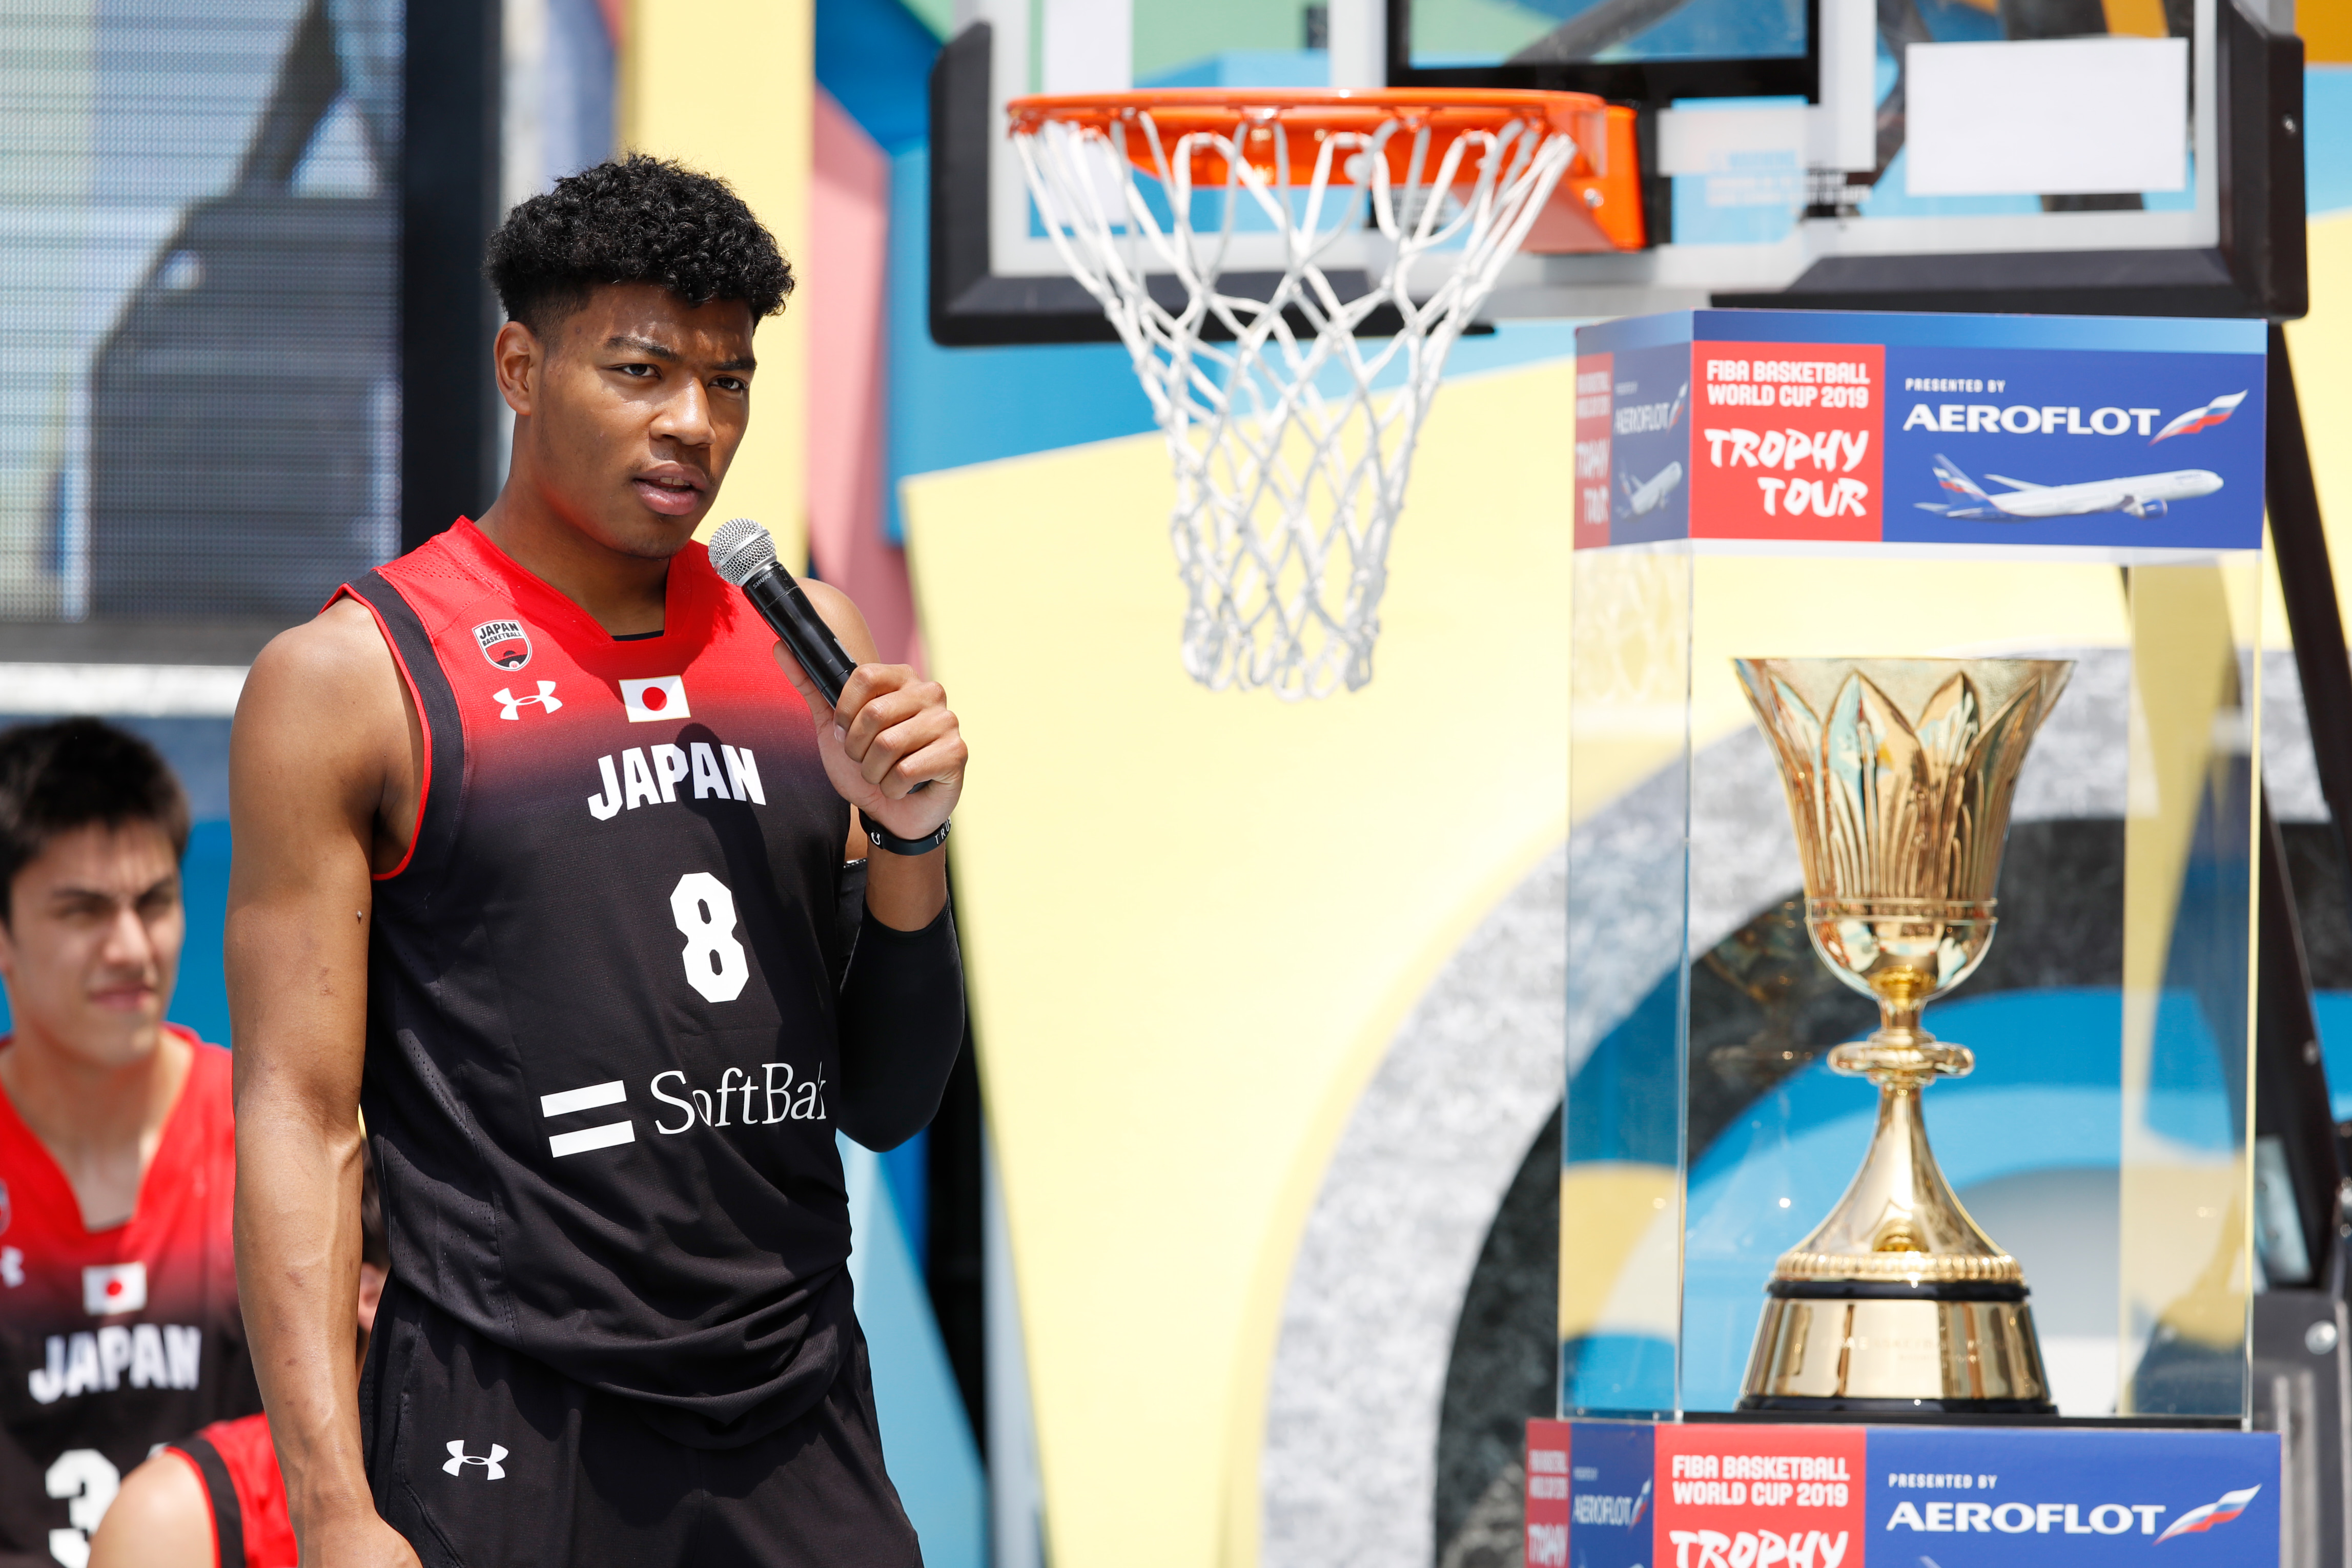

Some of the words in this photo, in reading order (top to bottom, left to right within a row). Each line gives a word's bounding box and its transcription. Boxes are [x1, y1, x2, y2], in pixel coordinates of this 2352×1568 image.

[1707, 360, 1750, 382] FIBA
[1753, 361, 1870, 385] BASKETBALL
[1905, 378, 1983, 393] PRESENTED
[1987, 380, 2006, 393] BY
[1707, 384, 1775, 406] WORLD
[1779, 385, 1817, 407] CUP
[1821, 386, 1869, 408] 2019
[1902, 403, 2161, 436] AEROFLOT
[1704, 428, 1869, 472] TROPHY
[1757, 477, 1869, 517] TOUR
[752, 571, 773, 589] SHURE
[479, 623, 519, 639] JAPAN
[482, 631, 522, 647] BASKETBALL
[587, 742, 767, 821] JAPAN
[670, 872, 750, 1003] 8
[28, 1324, 202, 1405] JAPAN
[1672, 1455, 1719, 1479] FIBA
[1723, 1456, 1850, 1481] BASKETBALL
[1889, 1473, 1973, 1489] PRESENTED
[1978, 1474, 1997, 1490] BY
[1672, 1481, 1747, 1505] WORLD
[1751, 1482, 1793, 1506] CUP
[1796, 1483, 1849, 1507] 2019
[1572, 1494, 1633, 1525] AEROFLOT
[1886, 1501, 2166, 1535] AEROFLOT
[1669, 1529, 1849, 1568] TROPHY
